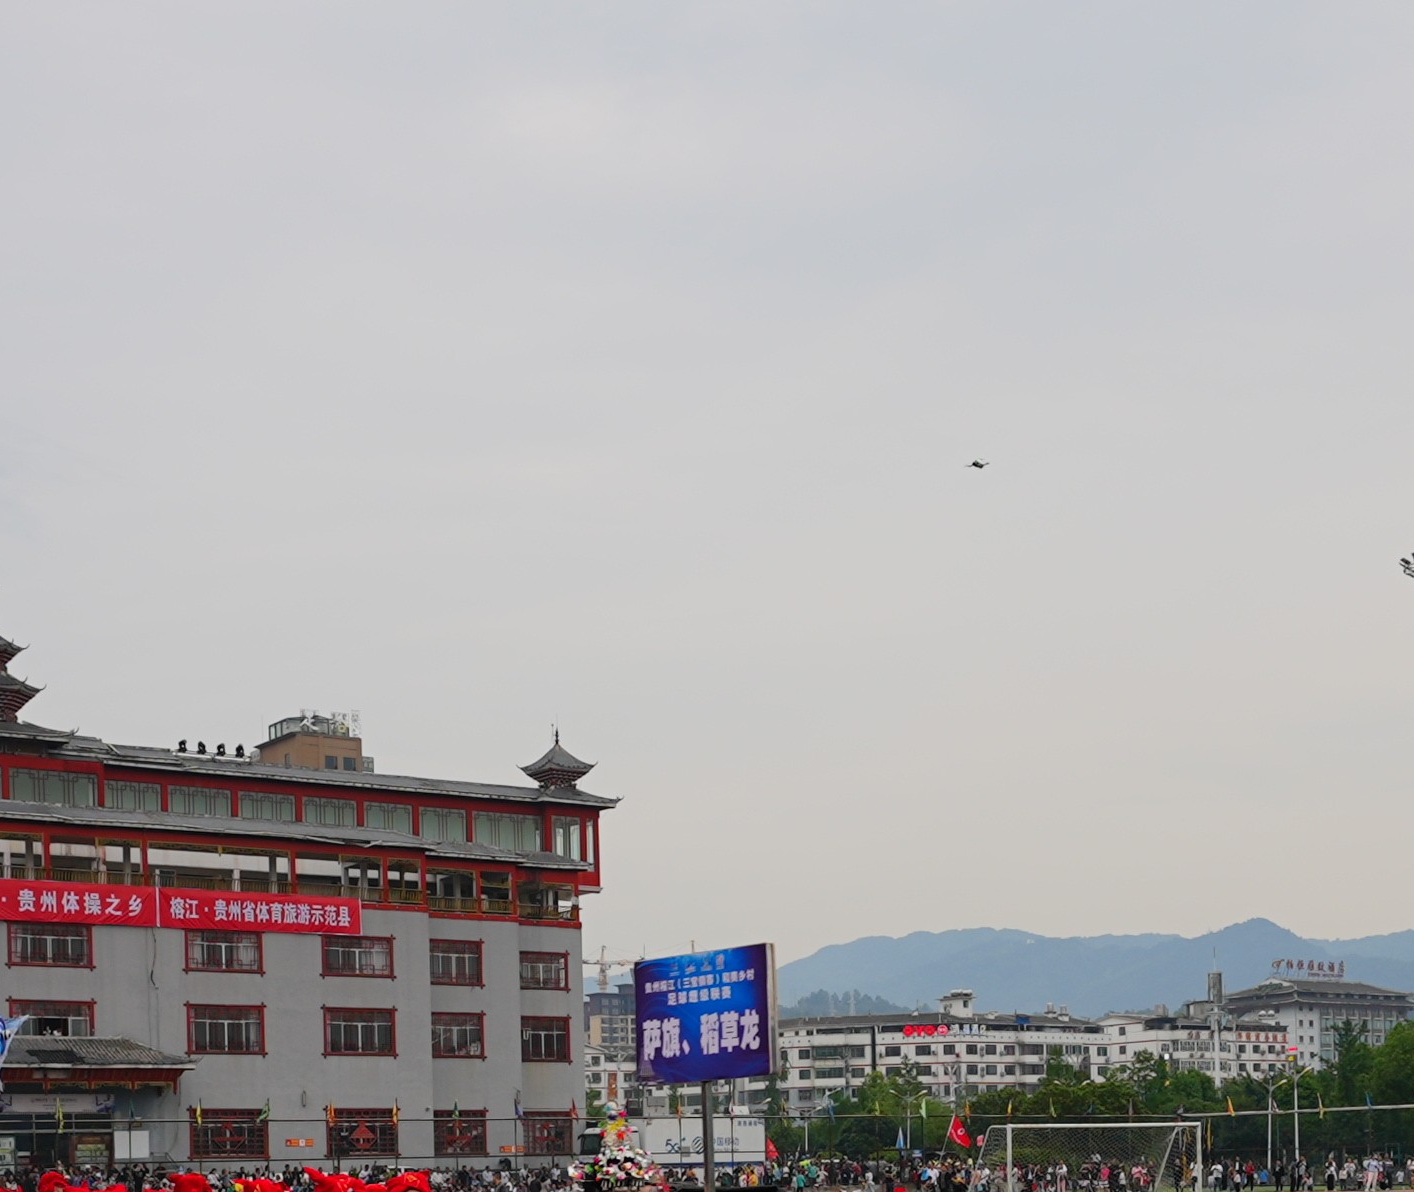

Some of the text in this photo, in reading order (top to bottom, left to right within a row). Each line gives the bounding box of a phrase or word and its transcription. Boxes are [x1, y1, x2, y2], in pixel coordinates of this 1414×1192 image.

[170, 896, 351, 927] 榕江·贵州省体育旅游示范县
[667, 985, 732, 1006] 足球超级联赛
[642, 1008, 761, 1061] 萨旗、稻草龙
